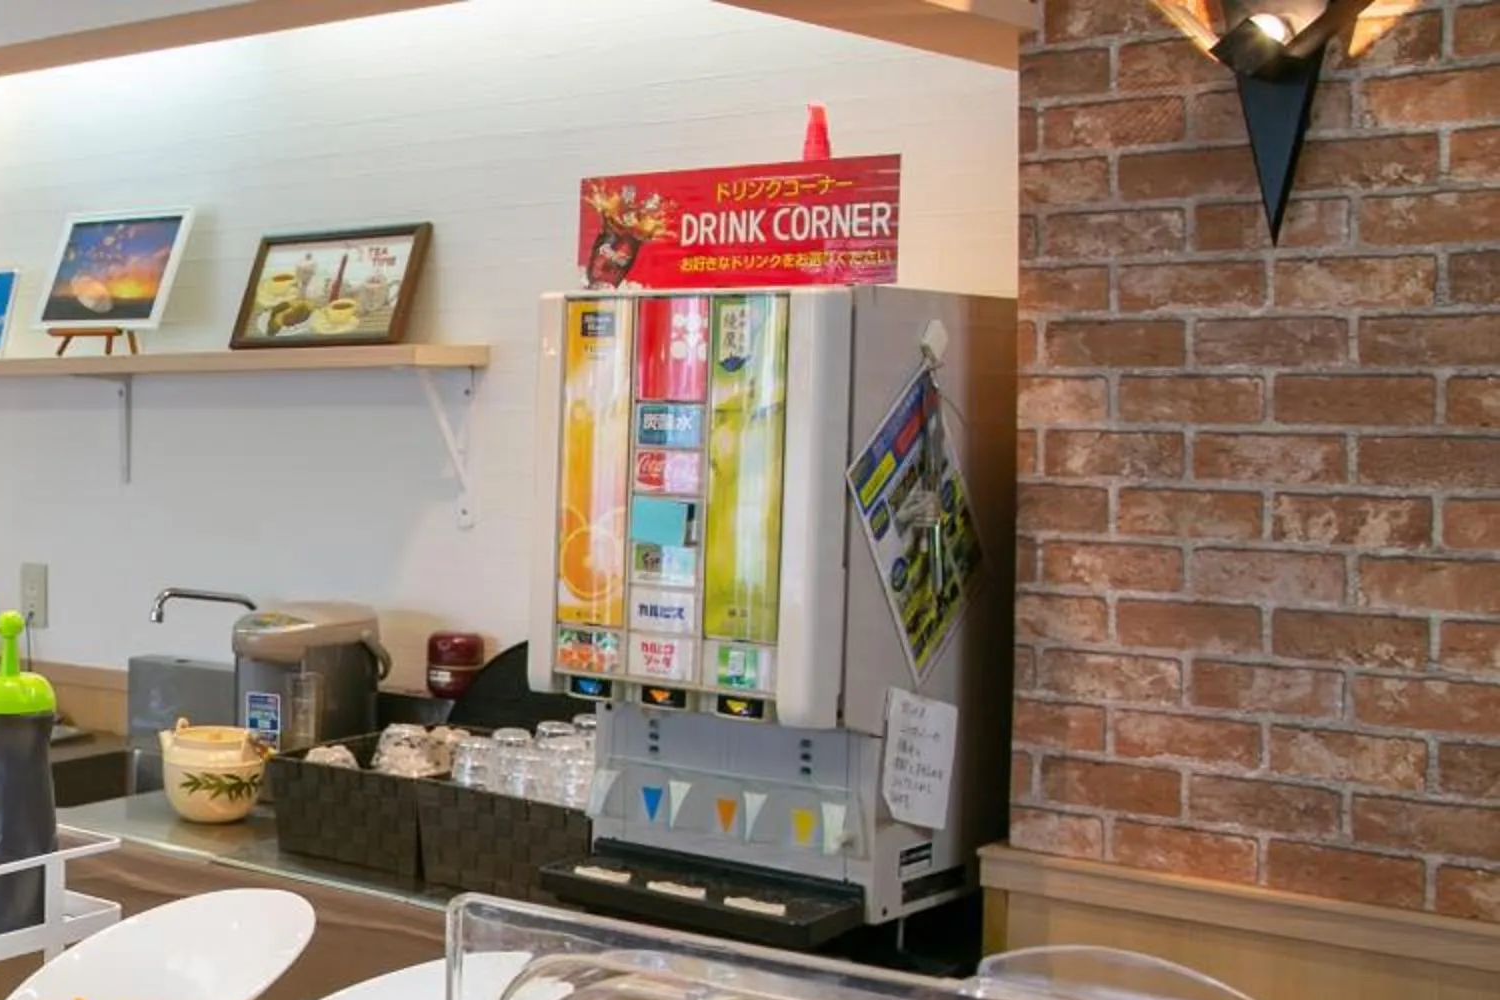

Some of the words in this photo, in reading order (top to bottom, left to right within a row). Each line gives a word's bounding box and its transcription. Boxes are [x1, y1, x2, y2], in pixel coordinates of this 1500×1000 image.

[716, 175, 853, 203] ドリンクコーナー
[680, 209, 767, 247] DRINK
[773, 202, 892, 241] CORNER
